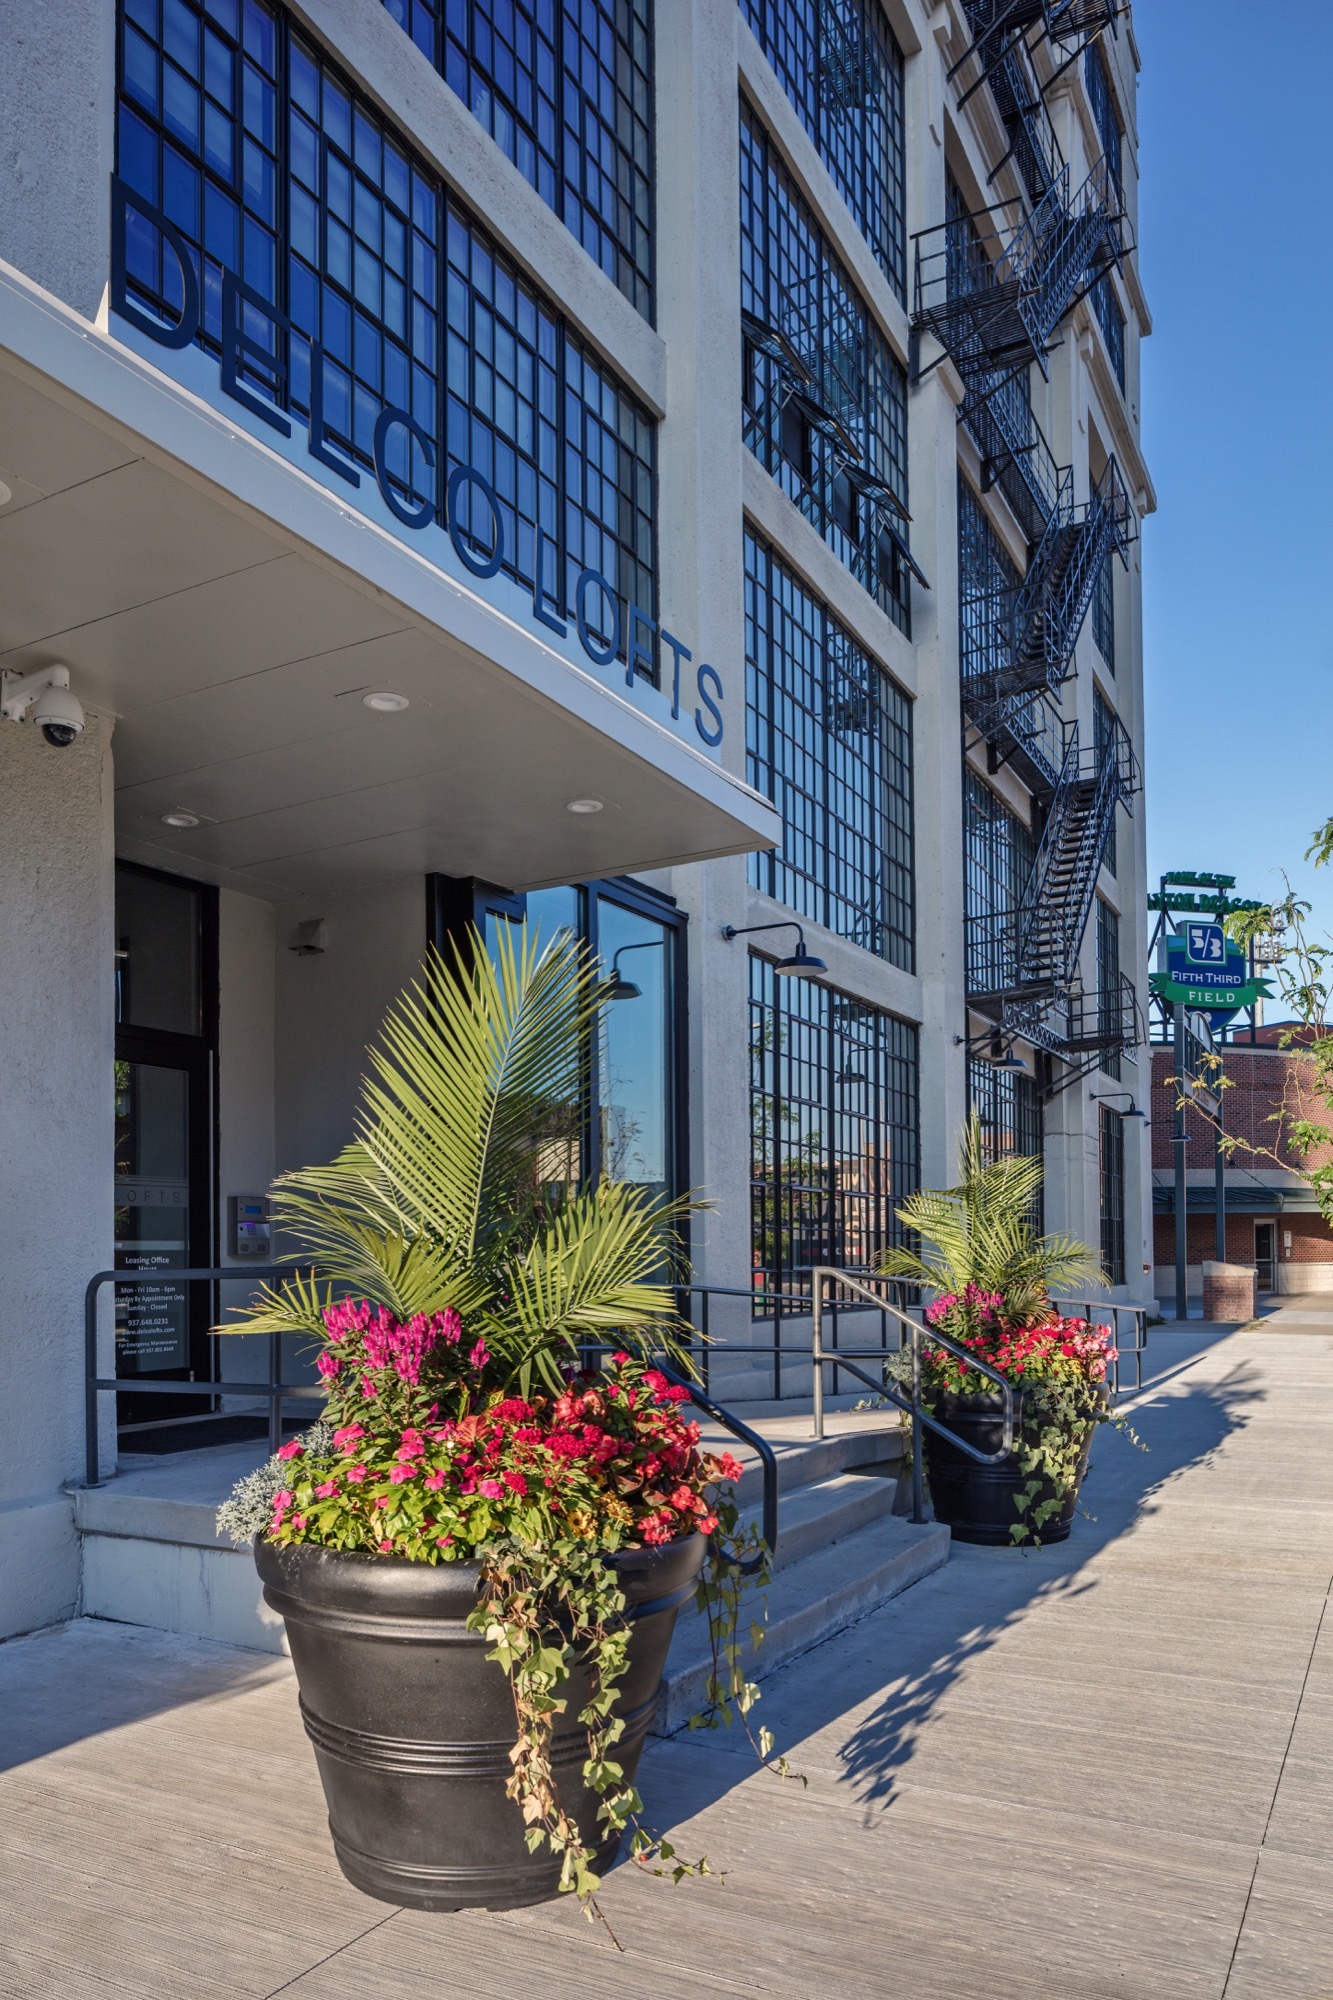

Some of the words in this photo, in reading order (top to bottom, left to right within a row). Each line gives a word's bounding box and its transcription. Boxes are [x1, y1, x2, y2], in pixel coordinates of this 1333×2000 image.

[110, 172, 504, 579] DELCO
[533, 523, 723, 747] LOFTS
[1171, 970, 1204, 983] FIFTH
[1205, 972, 1242, 985] THIRD
[1188, 991, 1236, 1003] FIELD
[115, 1189, 180, 1204] OFTS
[125, 1256, 150, 1265] Leasing
[150, 1256, 170, 1264] Office
[164, 1285, 176, 1293] 6pm
[134, 1295, 142, 1303] By
[142, 1294, 173, 1302] Appointment
[173, 1293, 185, 1301] Only
[127, 1318, 169, 1327] 937.648.0231
